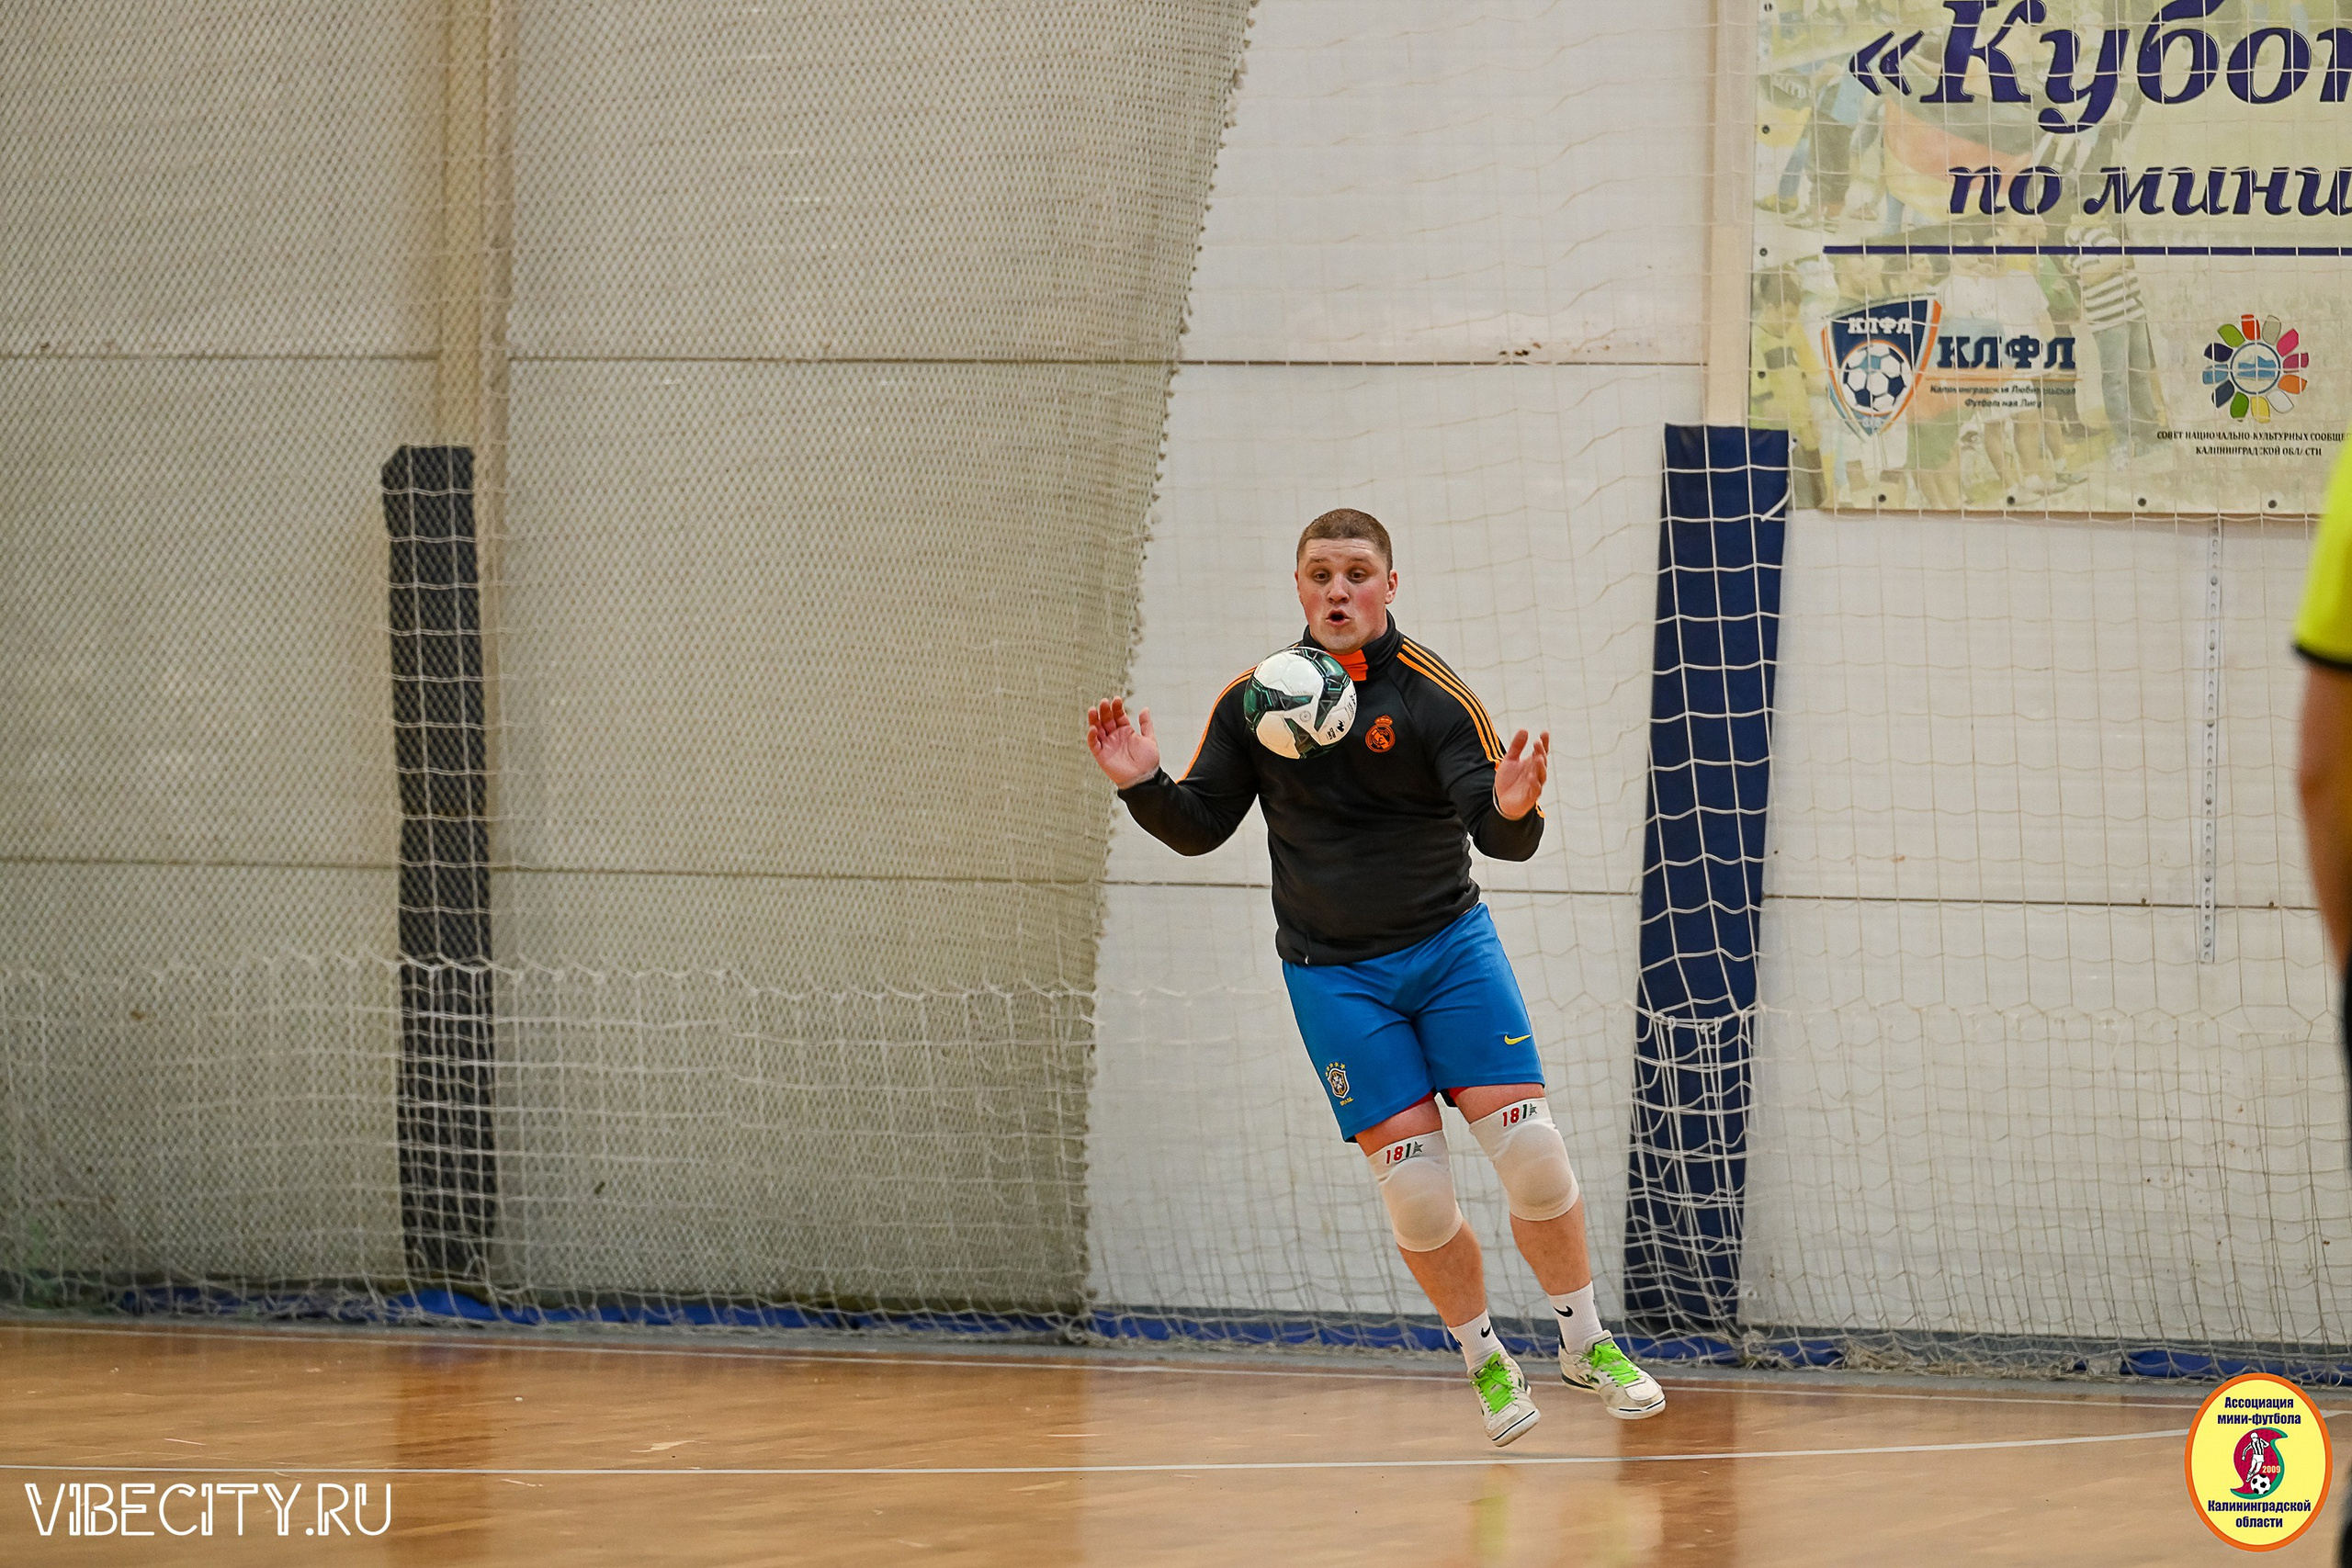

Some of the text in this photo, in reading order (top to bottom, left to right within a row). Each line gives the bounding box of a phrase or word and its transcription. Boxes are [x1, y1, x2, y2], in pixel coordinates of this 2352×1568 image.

[1948, 166, 2063, 215] по
[1849, 318, 1913, 335] КЛФЛ
[1937, 334, 2076, 369] КЛФЛ
[2156, 431, 2183, 440] СОВЕТ
[1503, 1103, 1528, 1127] 181
[1386, 1143, 1411, 1164] 181
